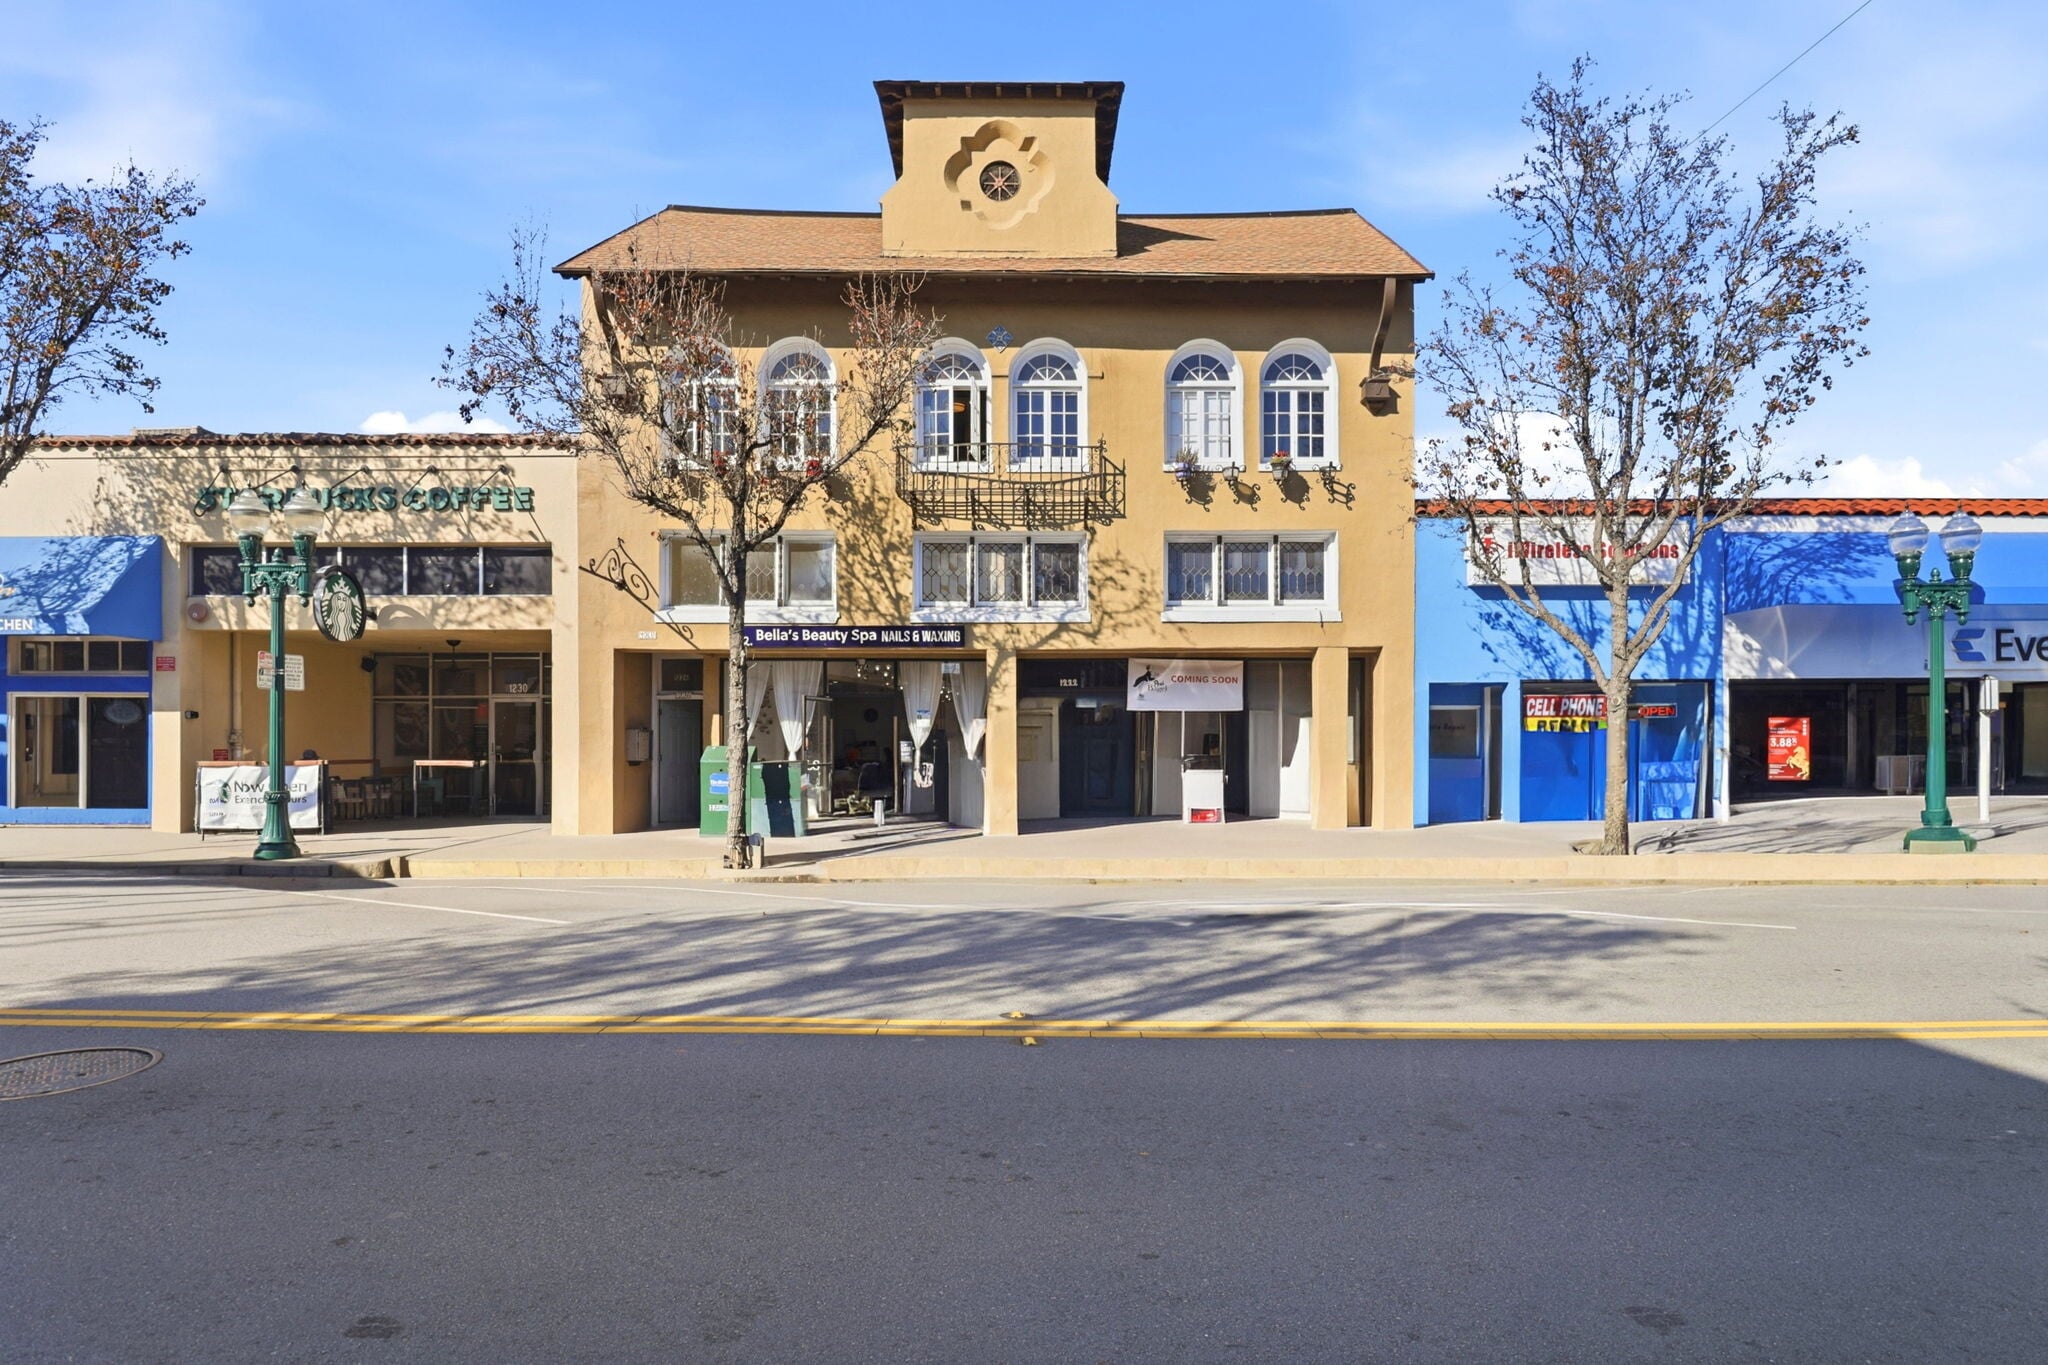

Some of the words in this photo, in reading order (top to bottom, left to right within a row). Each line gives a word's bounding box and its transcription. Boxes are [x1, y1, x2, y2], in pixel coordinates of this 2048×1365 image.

[404, 486, 534, 511] COFFEE
[756, 628, 799, 641] Bella's
[802, 629, 848, 644] Beauty
[851, 629, 877, 644] Spa
[881, 630, 910, 642] NAILS
[912, 630, 920, 642] &
[922, 630, 961, 642] WAXING
[1171, 675, 1209, 684] COMING
[1212, 676, 1239, 684] SOON
[509, 683, 528, 693] 1230
[1526, 698, 1556, 716] CELL
[1560, 697, 1604, 716] PHONE
[1638, 706, 1675, 716] OPEN
